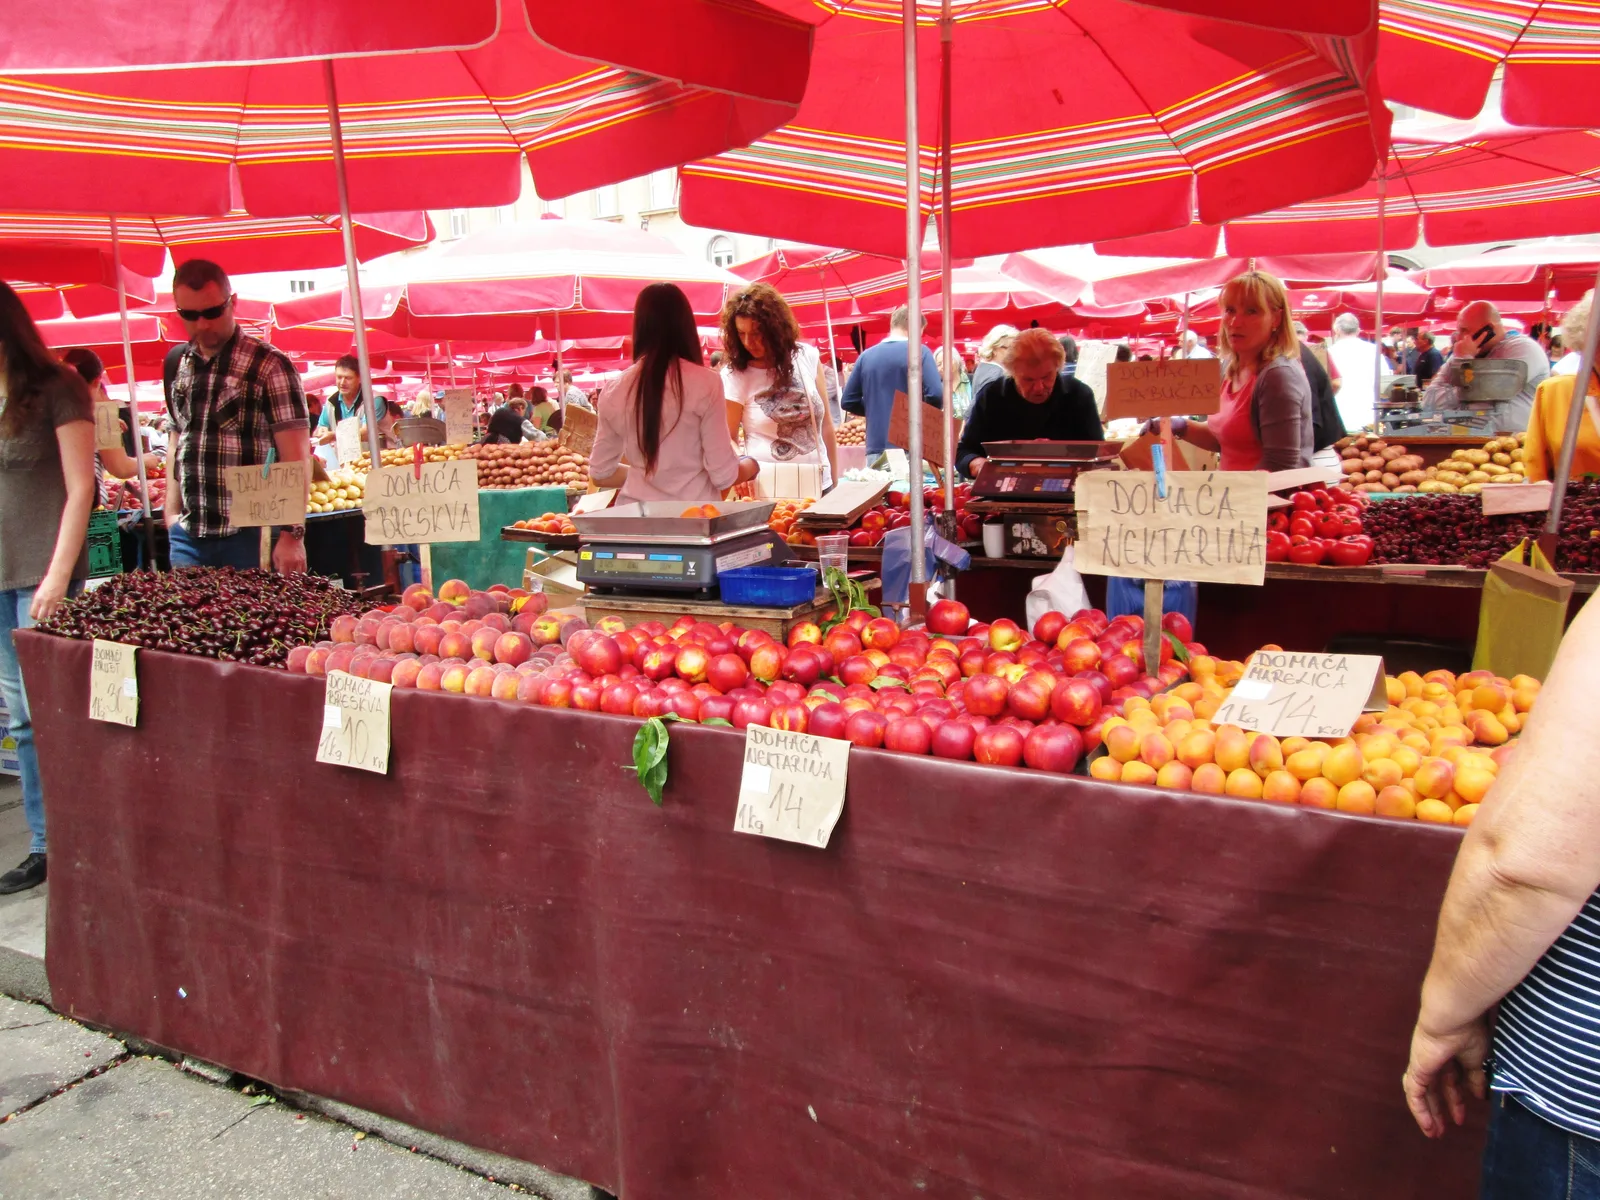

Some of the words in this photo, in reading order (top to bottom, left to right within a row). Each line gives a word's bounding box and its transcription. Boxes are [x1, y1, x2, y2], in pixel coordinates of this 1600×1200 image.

[381, 463, 462, 498] DOMAĆA
[1107, 473, 1236, 519] DOMAĆA
[376, 501, 473, 539] BRESKVA
[1102, 521, 1262, 567] NEKTARINA
[1249, 668, 1347, 689] MARELICA
[1254, 652, 1348, 671] DOMAĆA
[327, 689, 385, 715] BRESKVA
[328, 673, 372, 697] DOMAĆA
[1268, 692, 1318, 734] 14
[342, 716, 370, 765] 10
[750, 729, 822, 758] DOMAĆA
[745, 747, 833, 780] NEKTARINA
[769, 782, 804, 829] 14
